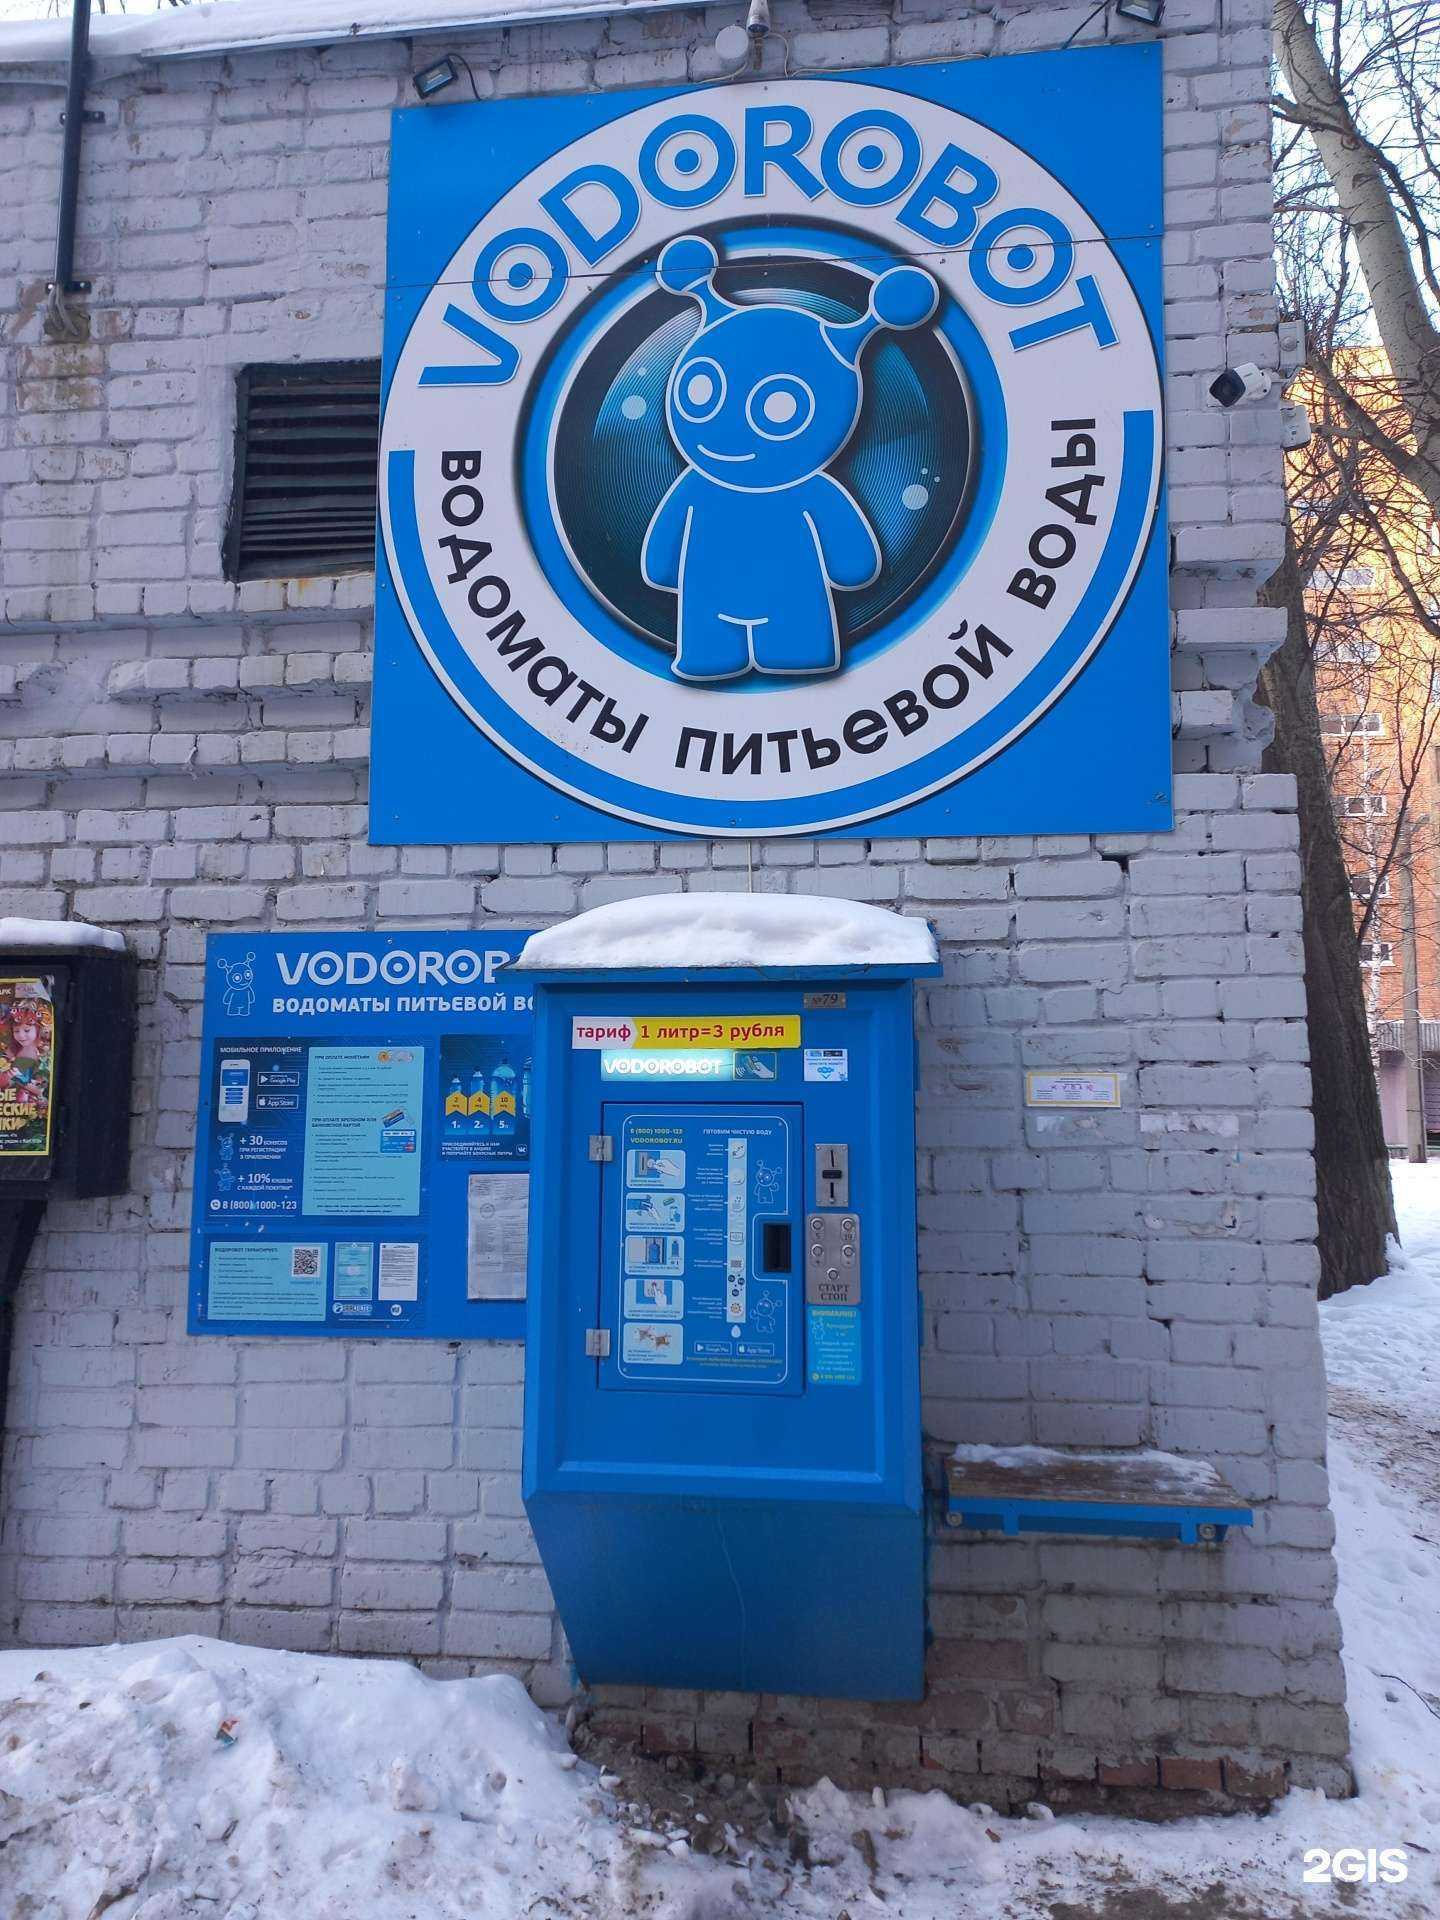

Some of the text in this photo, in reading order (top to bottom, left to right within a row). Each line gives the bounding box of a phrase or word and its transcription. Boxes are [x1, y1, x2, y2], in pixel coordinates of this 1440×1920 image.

[418, 105, 1120, 388] VODOROBOT
[272, 997, 391, 1015] ВОДОМАТЫ
[397, 992, 507, 1012] ПИТЬЕВОЙ
[576, 1024, 632, 1041] тариф
[641, 1025, 650, 1038] 1
[730, 1023, 784, 1041] рубля
[603, 1058, 723, 1075] VODOROBOT
[249, 1135, 263, 1146] 30
[248, 1173, 271, 1184] 10%
[222, 1200, 297, 1210] 8 (800) 1000-123
[818, 1284, 850, 1292] СТАРТ
[820, 1293, 847, 1302] СТОП
